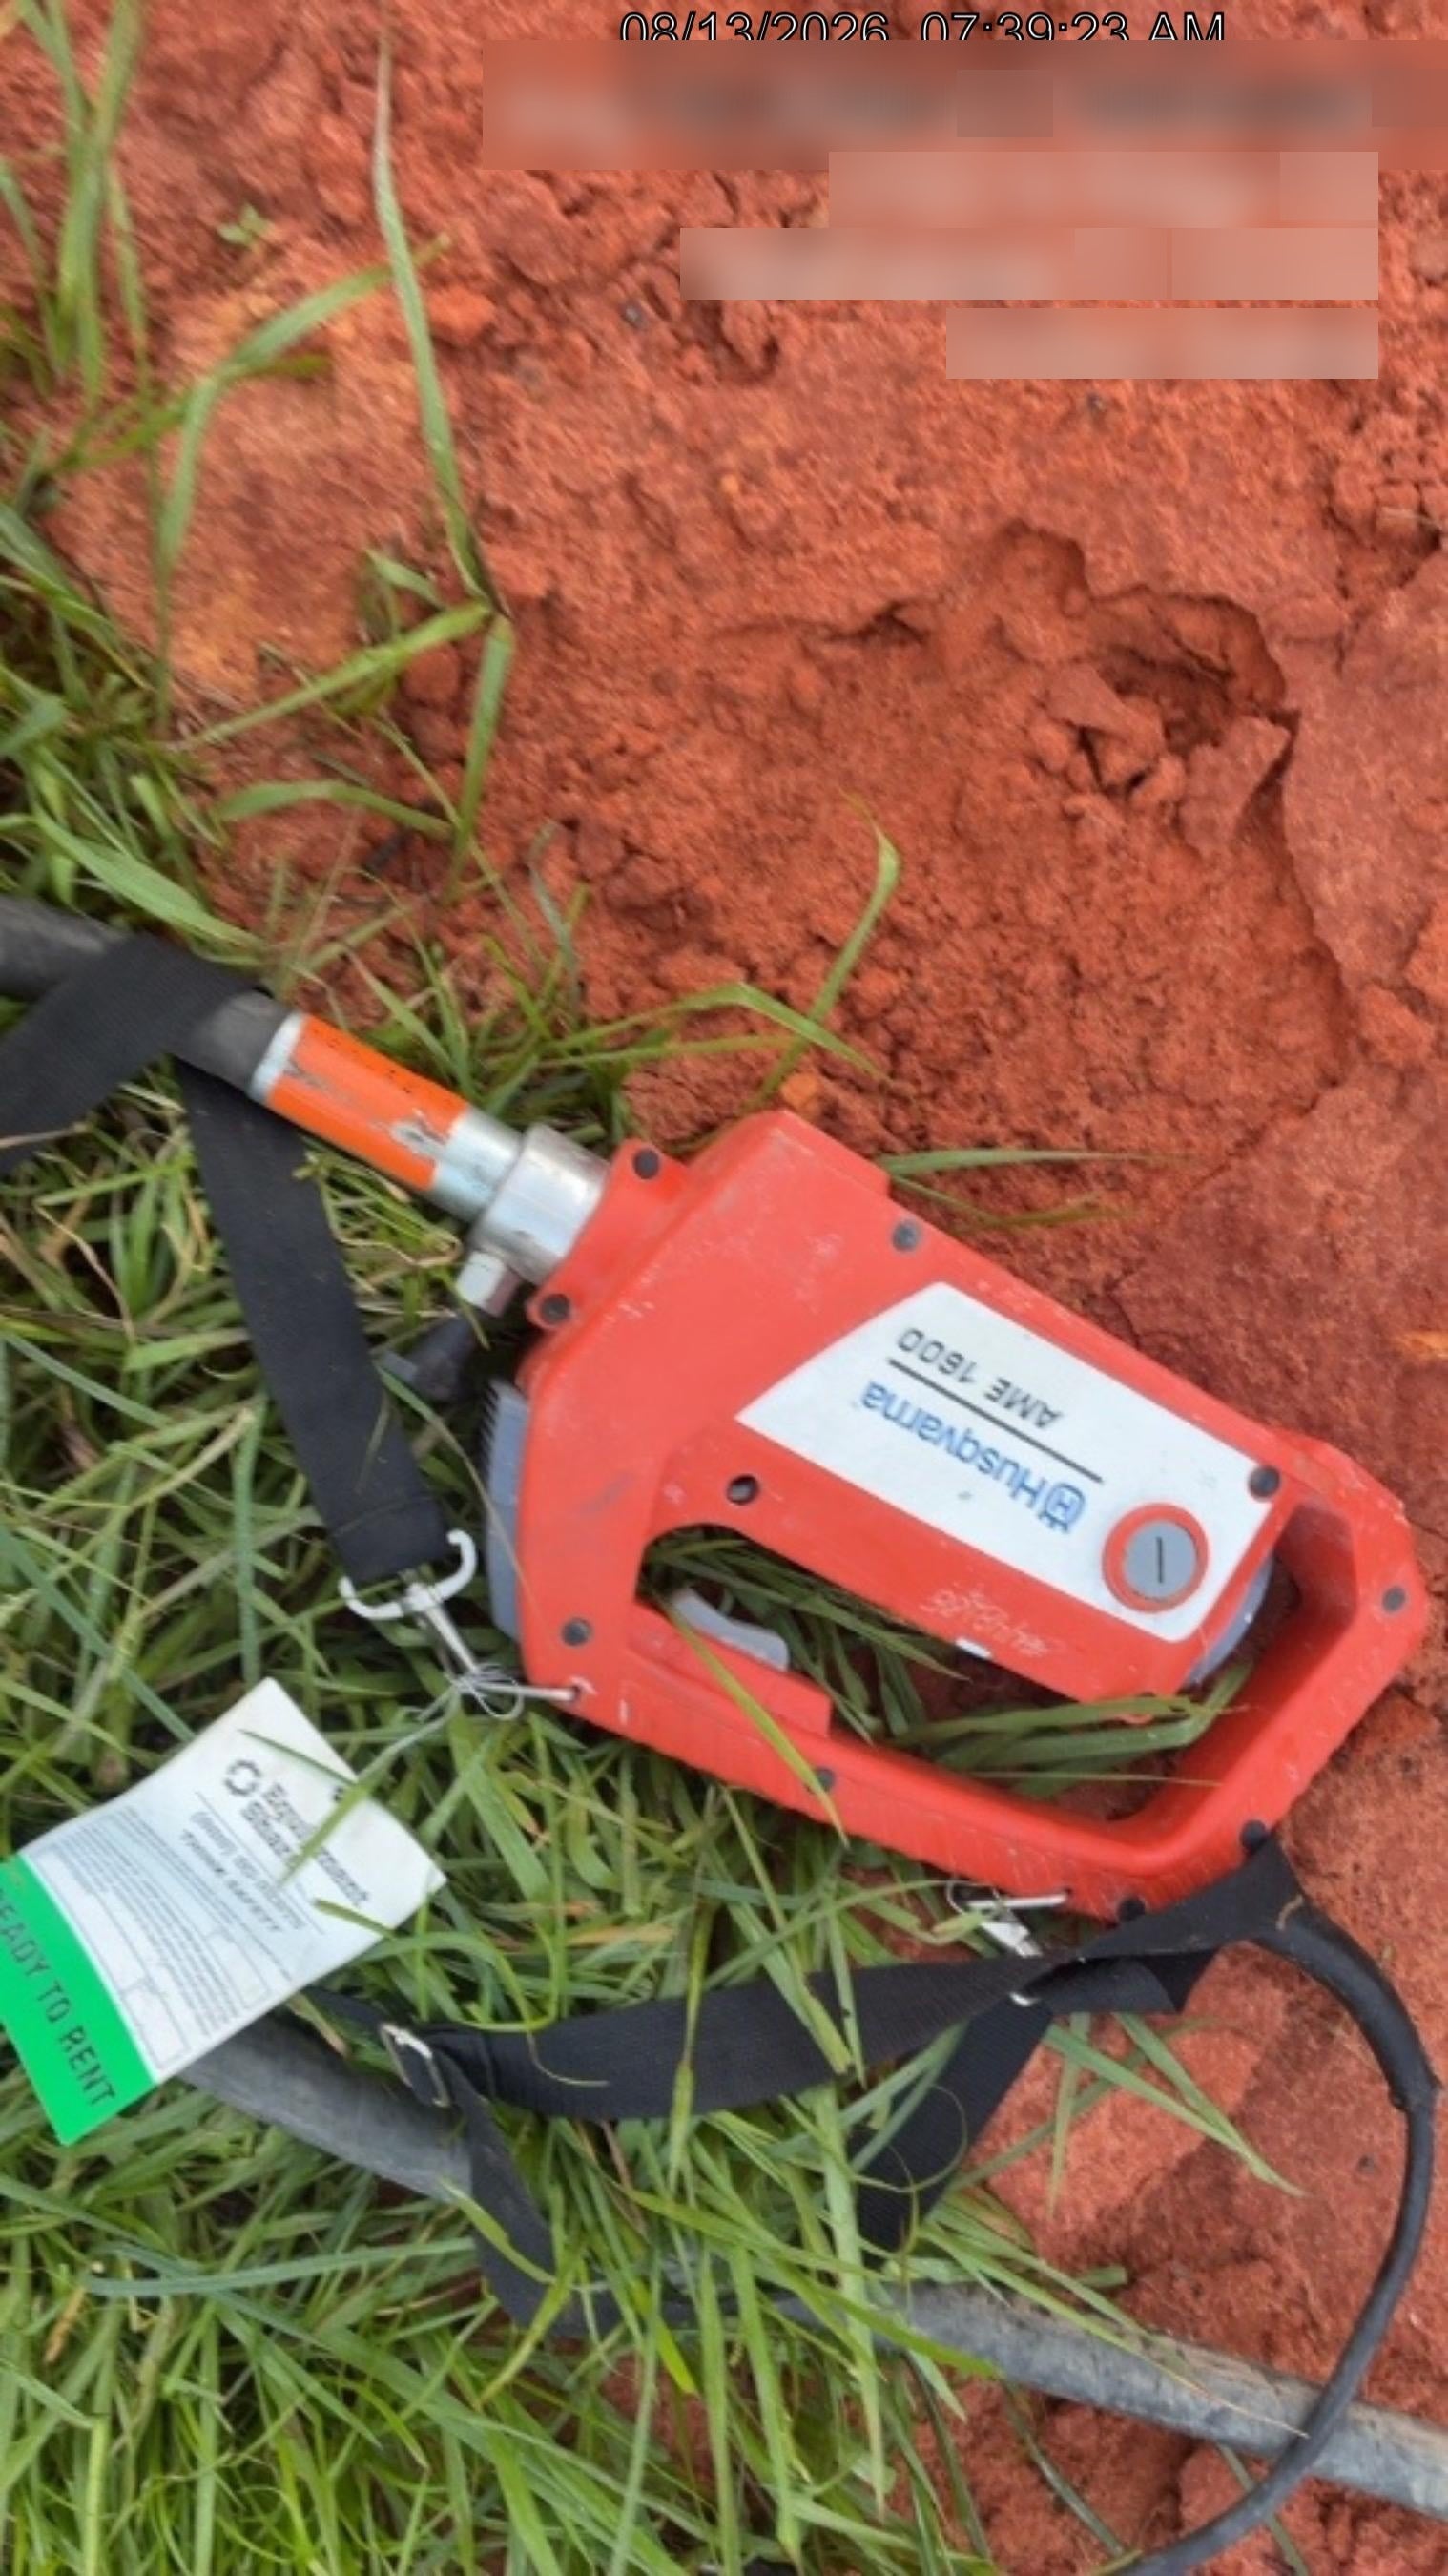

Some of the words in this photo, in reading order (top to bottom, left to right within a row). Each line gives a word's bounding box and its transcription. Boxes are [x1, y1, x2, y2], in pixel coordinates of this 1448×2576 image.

[897, 1327, 977, 1383] 1600
[860, 1381, 1046, 1508] Husqvarna
[983, 1377, 1063, 1429] AME
[0, 1885, 49, 1977] EADY
[37, 1980, 72, 2024] TO
[59, 2025, 115, 2105] RENT
